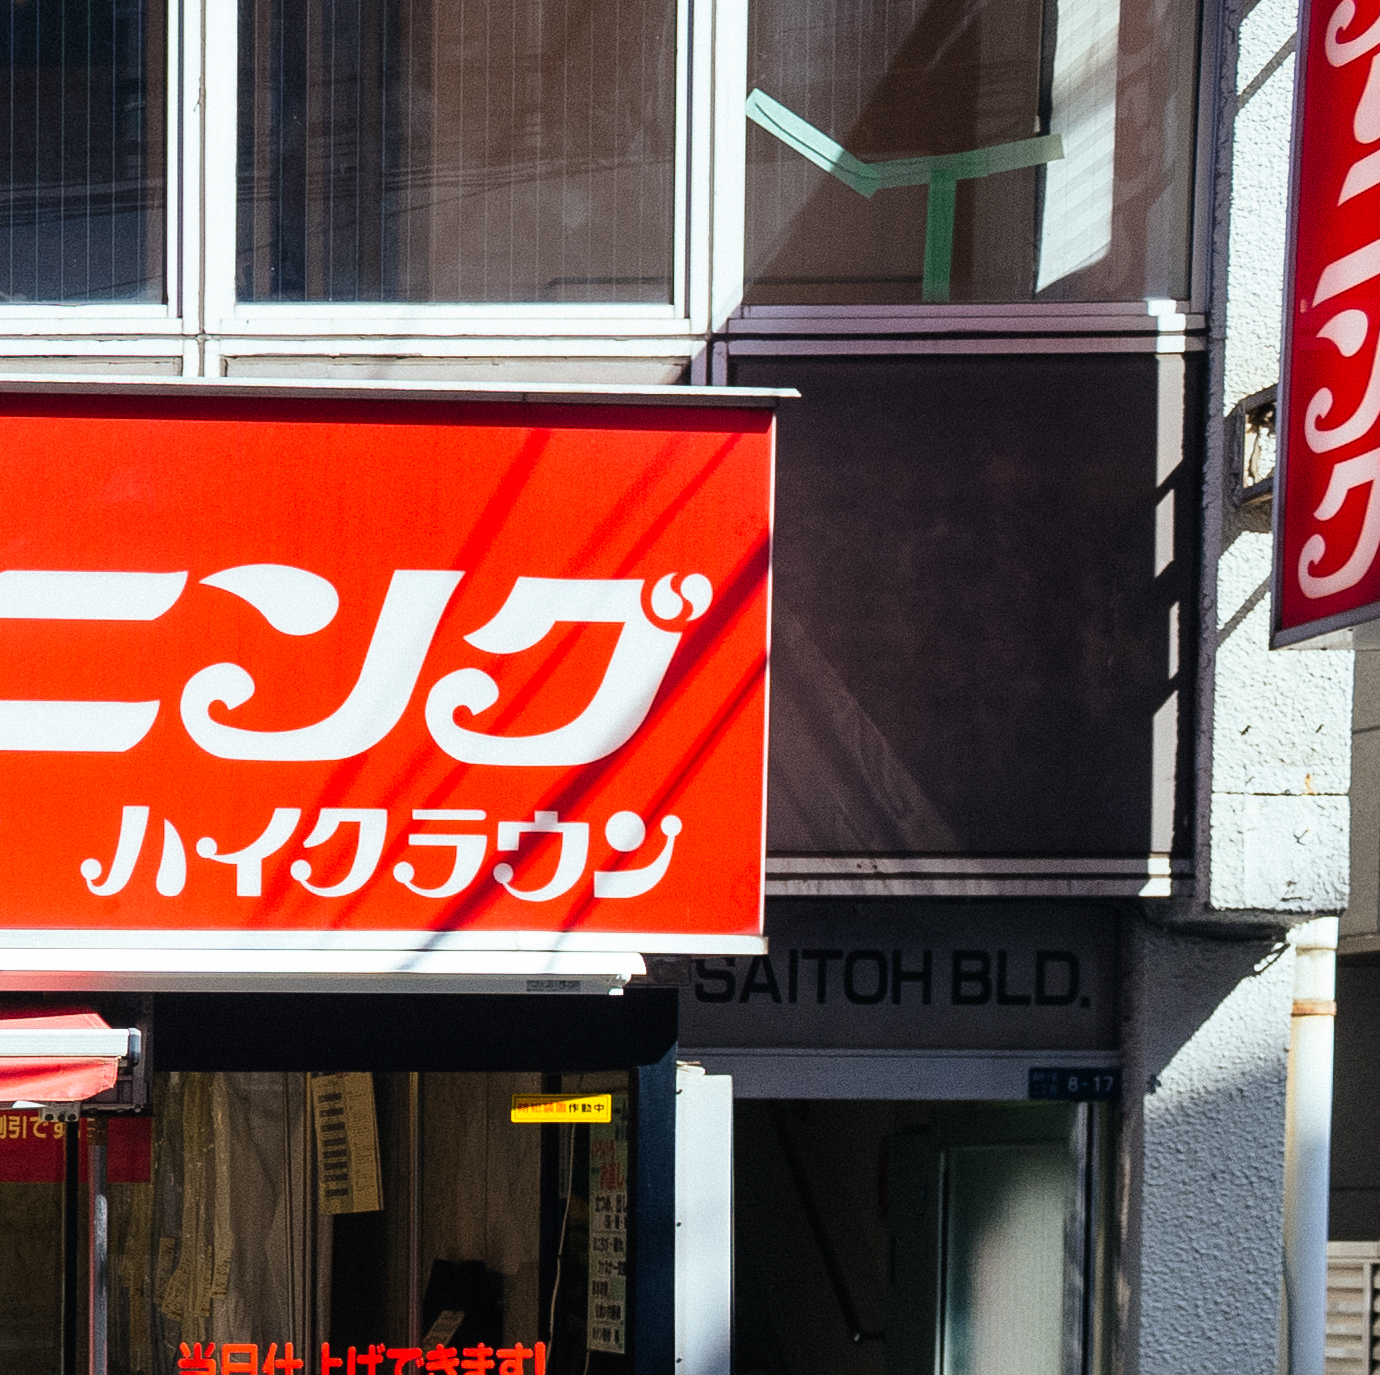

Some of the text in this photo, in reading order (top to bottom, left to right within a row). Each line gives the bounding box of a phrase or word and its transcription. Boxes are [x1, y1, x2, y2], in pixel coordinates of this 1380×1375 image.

[81, 805, 682, 900] ハイクラウン
[694, 949, 1090, 1009] SAITOH BLD.
[1067, 1075, 1114, 1093] 8-17
